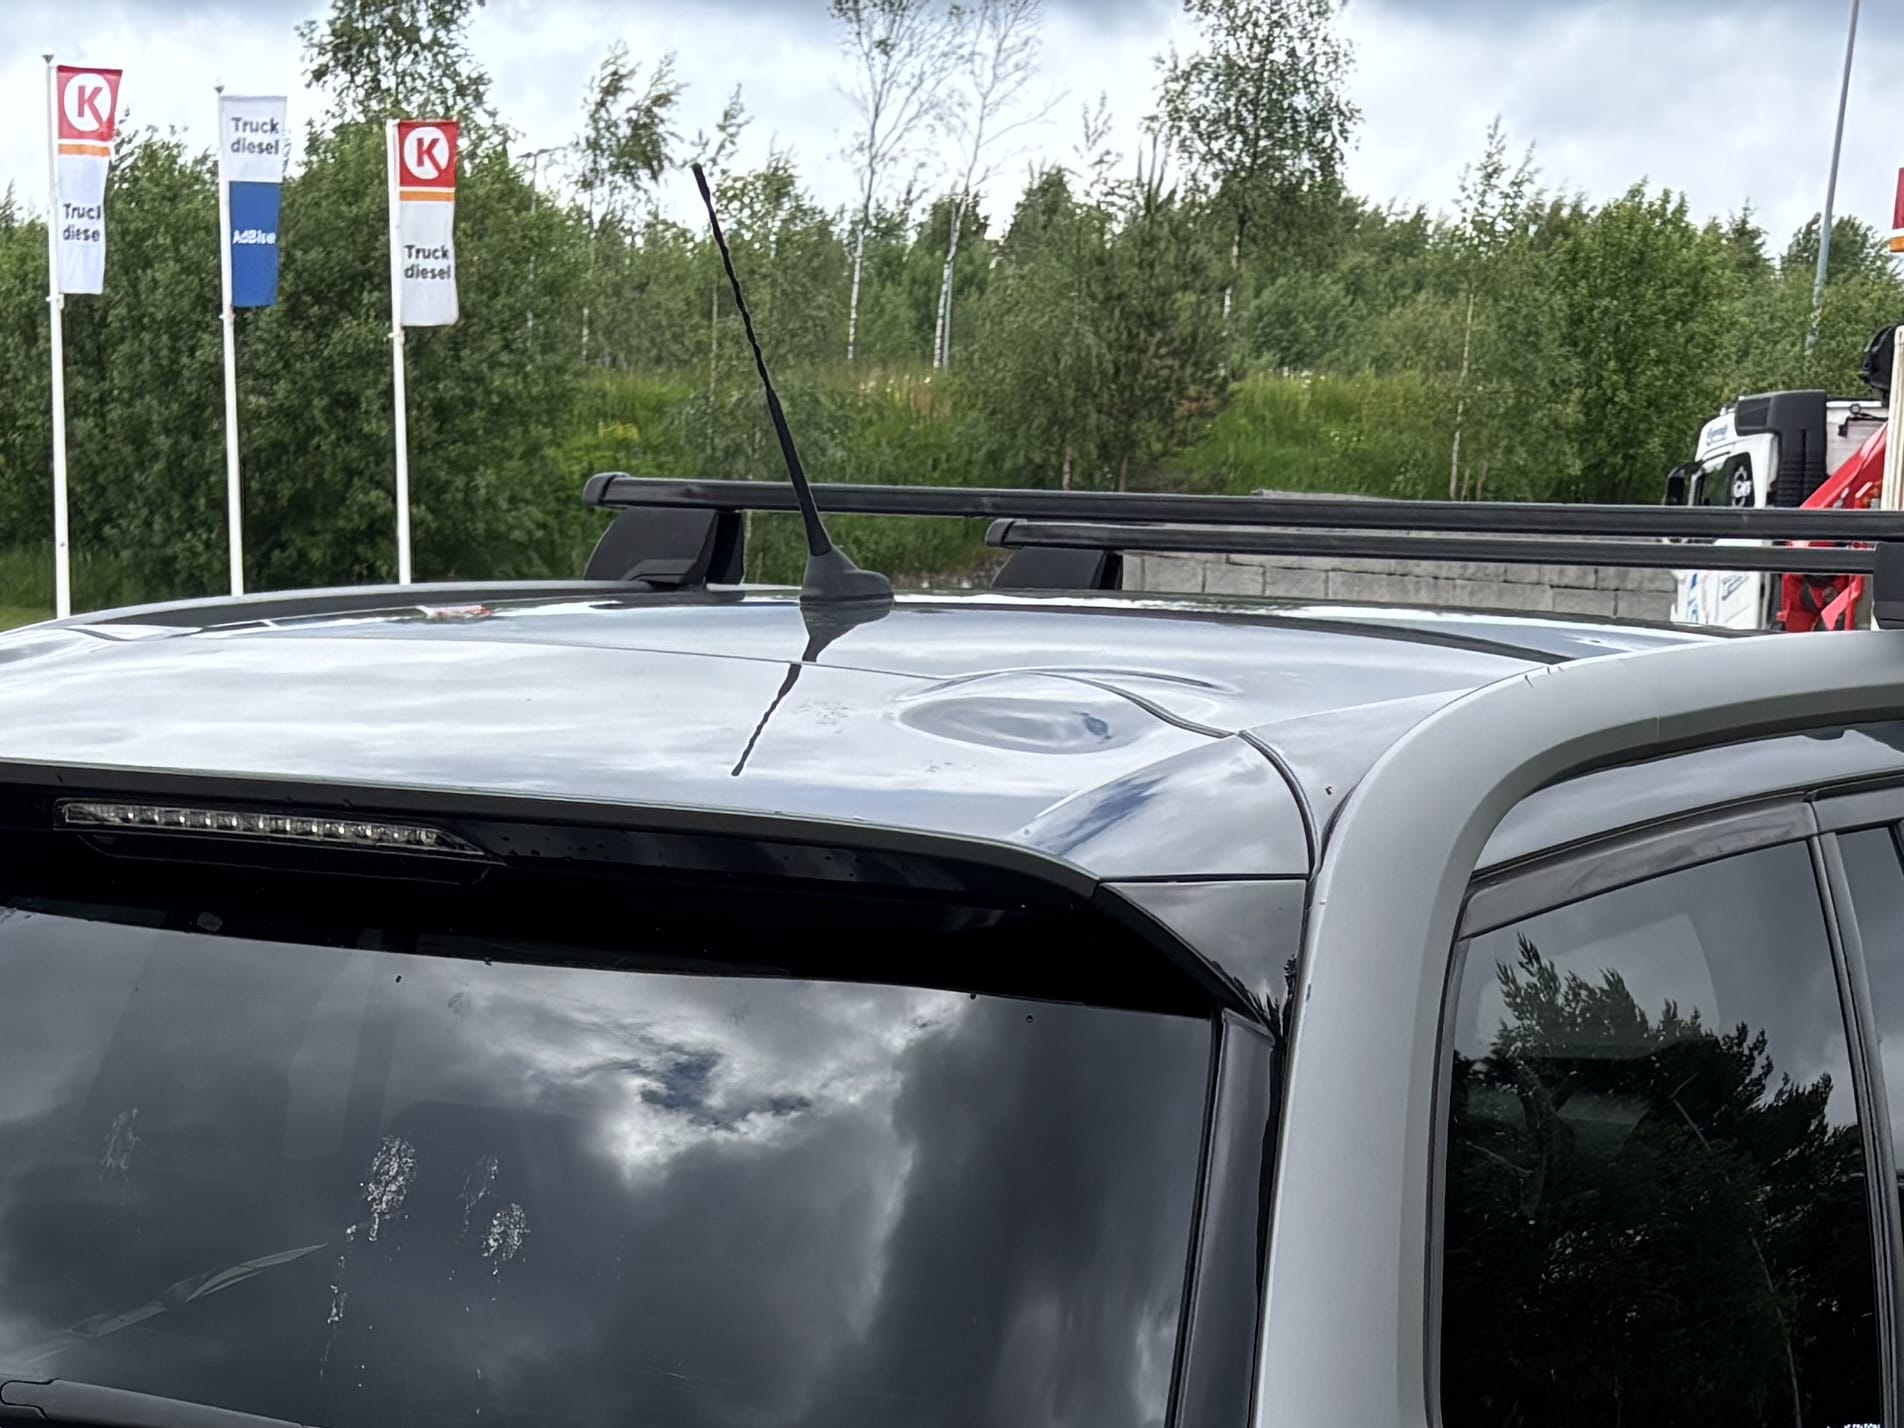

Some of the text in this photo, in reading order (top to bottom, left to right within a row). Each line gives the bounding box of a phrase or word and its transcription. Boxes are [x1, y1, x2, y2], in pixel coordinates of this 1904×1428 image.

[231, 117, 280, 134] Truck
[231, 137, 279, 155] diesel
[62, 224, 101, 242] diese
[404, 244, 450, 260] Truck
[404, 264, 451, 279] diesel
